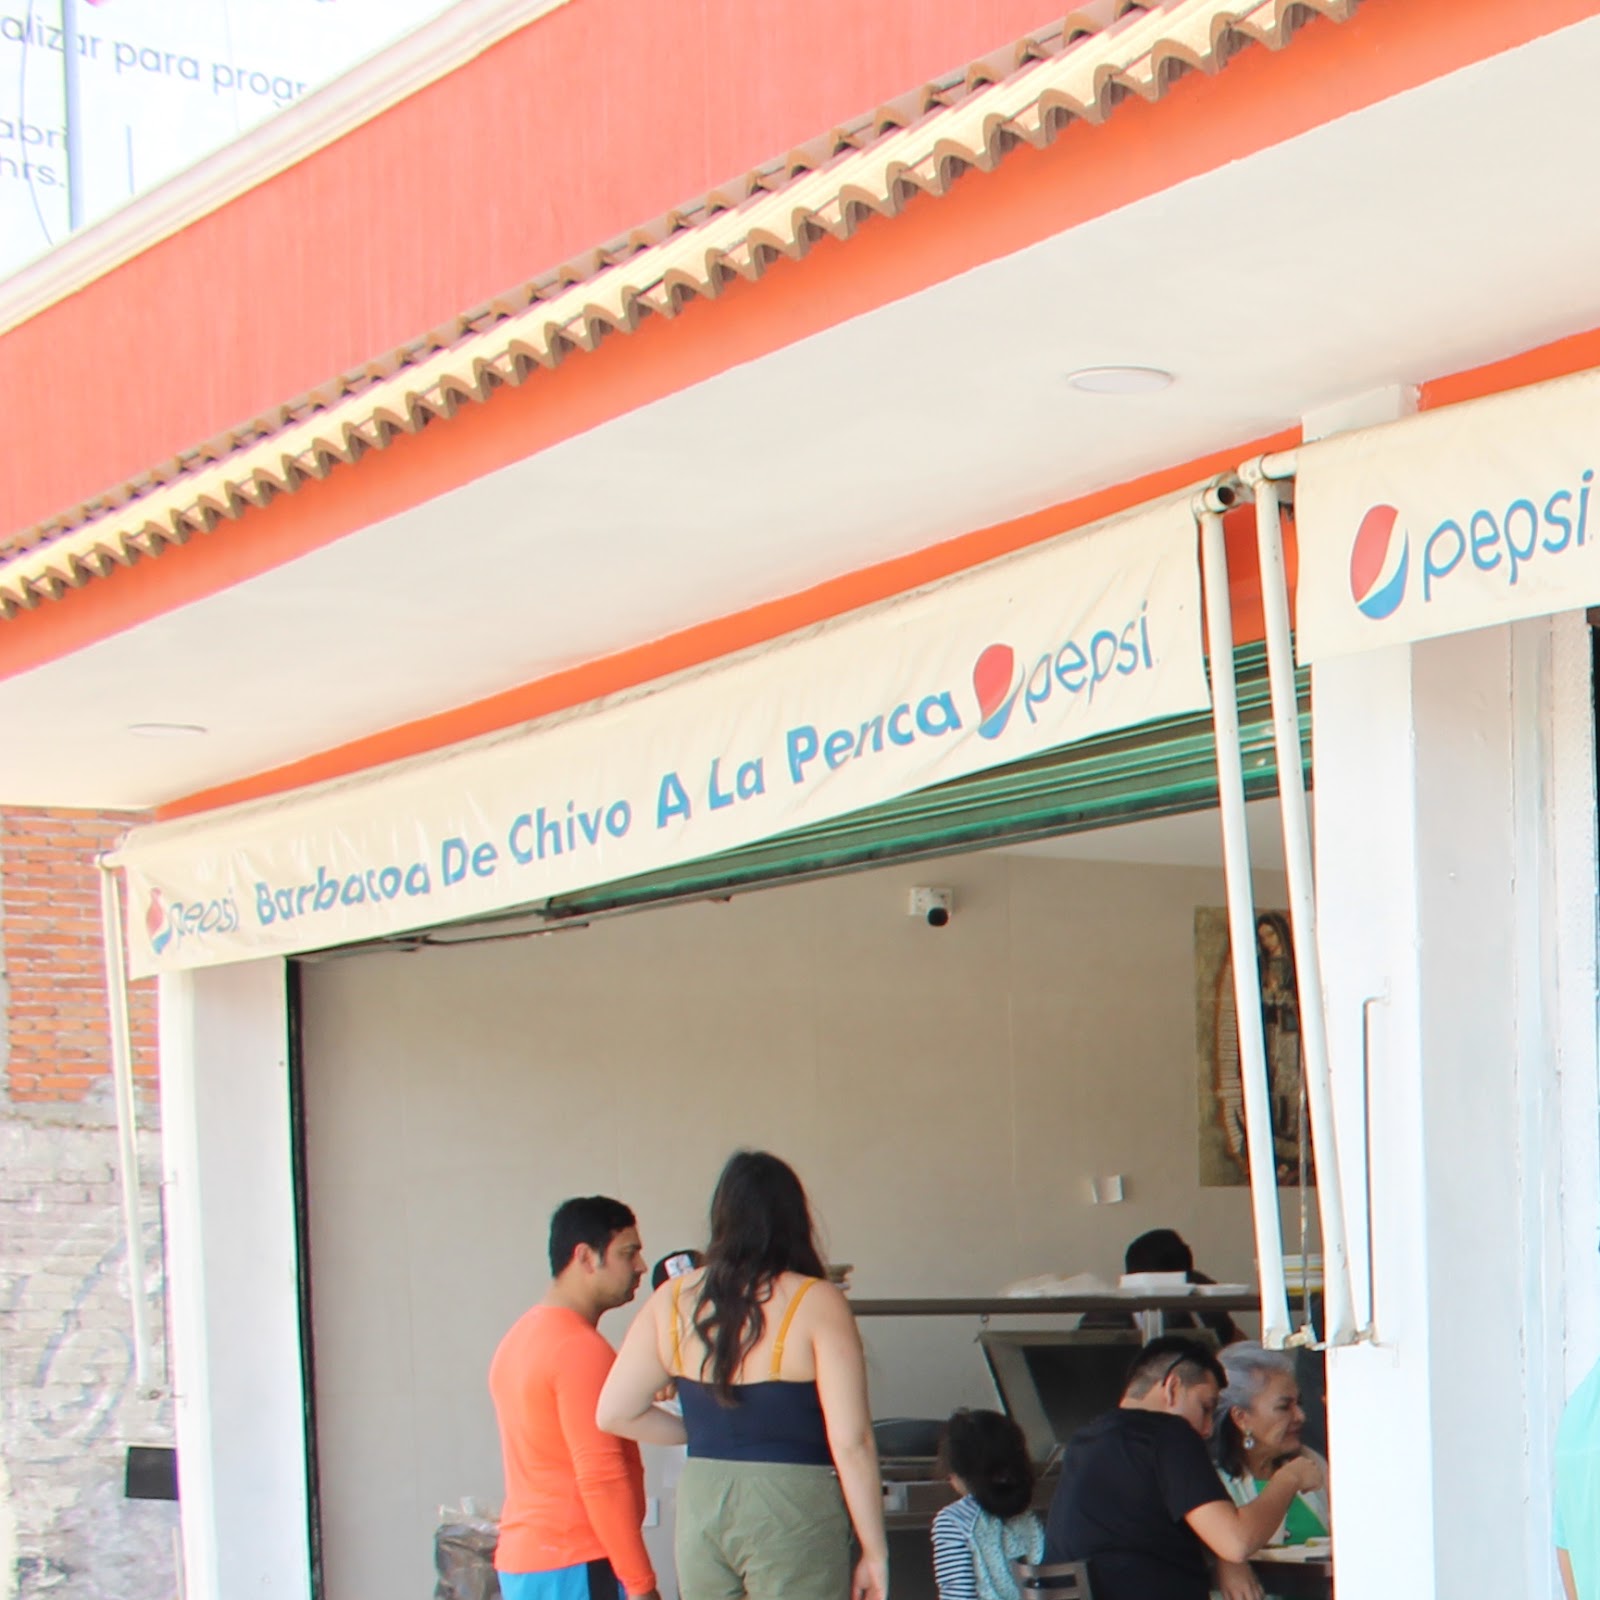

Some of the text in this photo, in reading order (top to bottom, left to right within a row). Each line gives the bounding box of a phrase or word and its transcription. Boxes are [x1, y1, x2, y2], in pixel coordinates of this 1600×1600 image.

[112, 40, 201, 82] para
[1421, 468, 1594, 603] pepsi
[255, 866, 431, 925] Barbacoa
[441, 838, 497, 886] De
[507, 799, 631, 865] Chivo
[656, 772, 692, 829] A
[708, 757, 766, 810] La
[786, 691, 963, 784] Penca
[1024, 600, 1153, 724] pepsi
